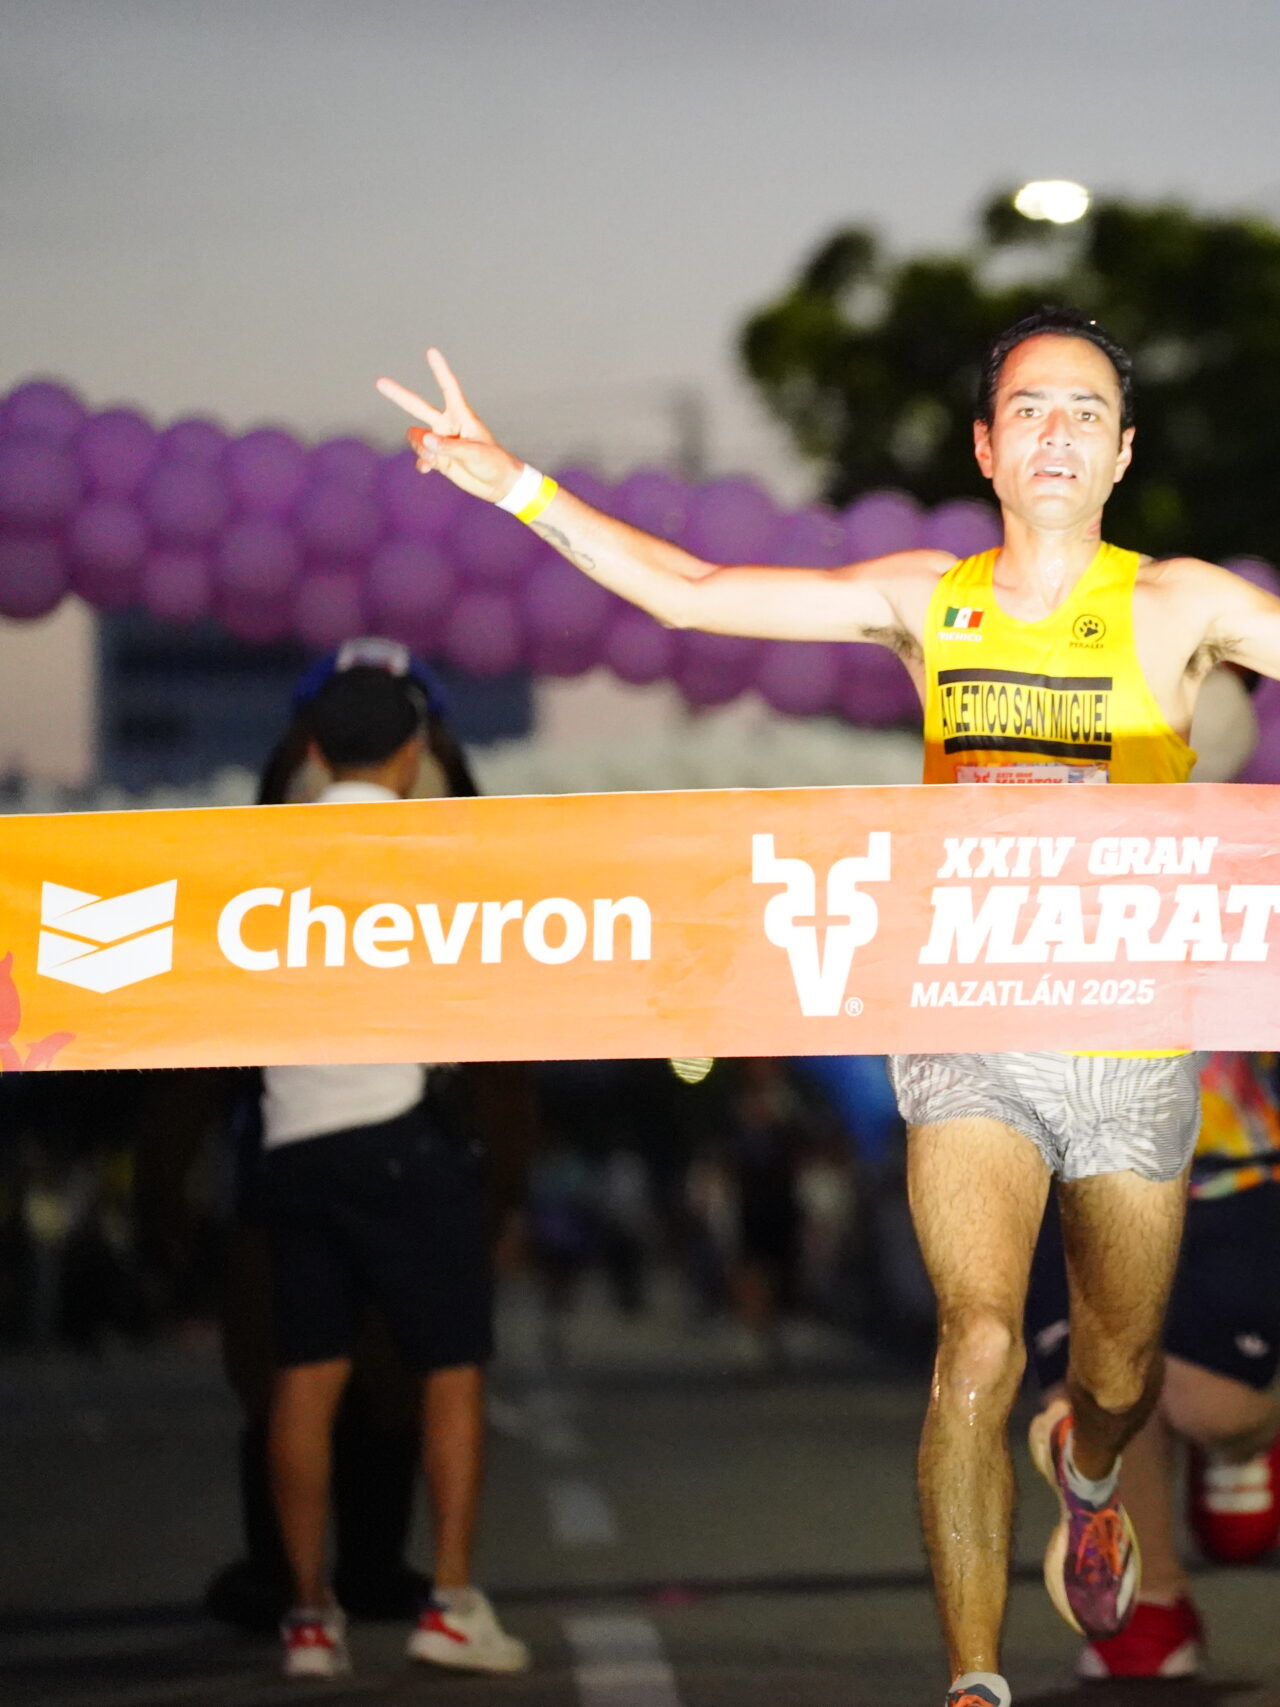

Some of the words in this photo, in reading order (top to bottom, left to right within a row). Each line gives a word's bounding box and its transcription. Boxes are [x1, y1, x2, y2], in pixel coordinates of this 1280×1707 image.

[941, 685, 1008, 736] ATLETICO
[1014, 687, 1046, 737] SAN
[1050, 693, 1112, 742] MIGUEL
[937, 837, 1076, 878] XXIV
[1088, 837, 1219, 875] GRAN
[218, 887, 652, 970] Chevron
[910, 973, 1076, 1008] MAZATLÁN
[1080, 978, 1156, 1006] 2025
